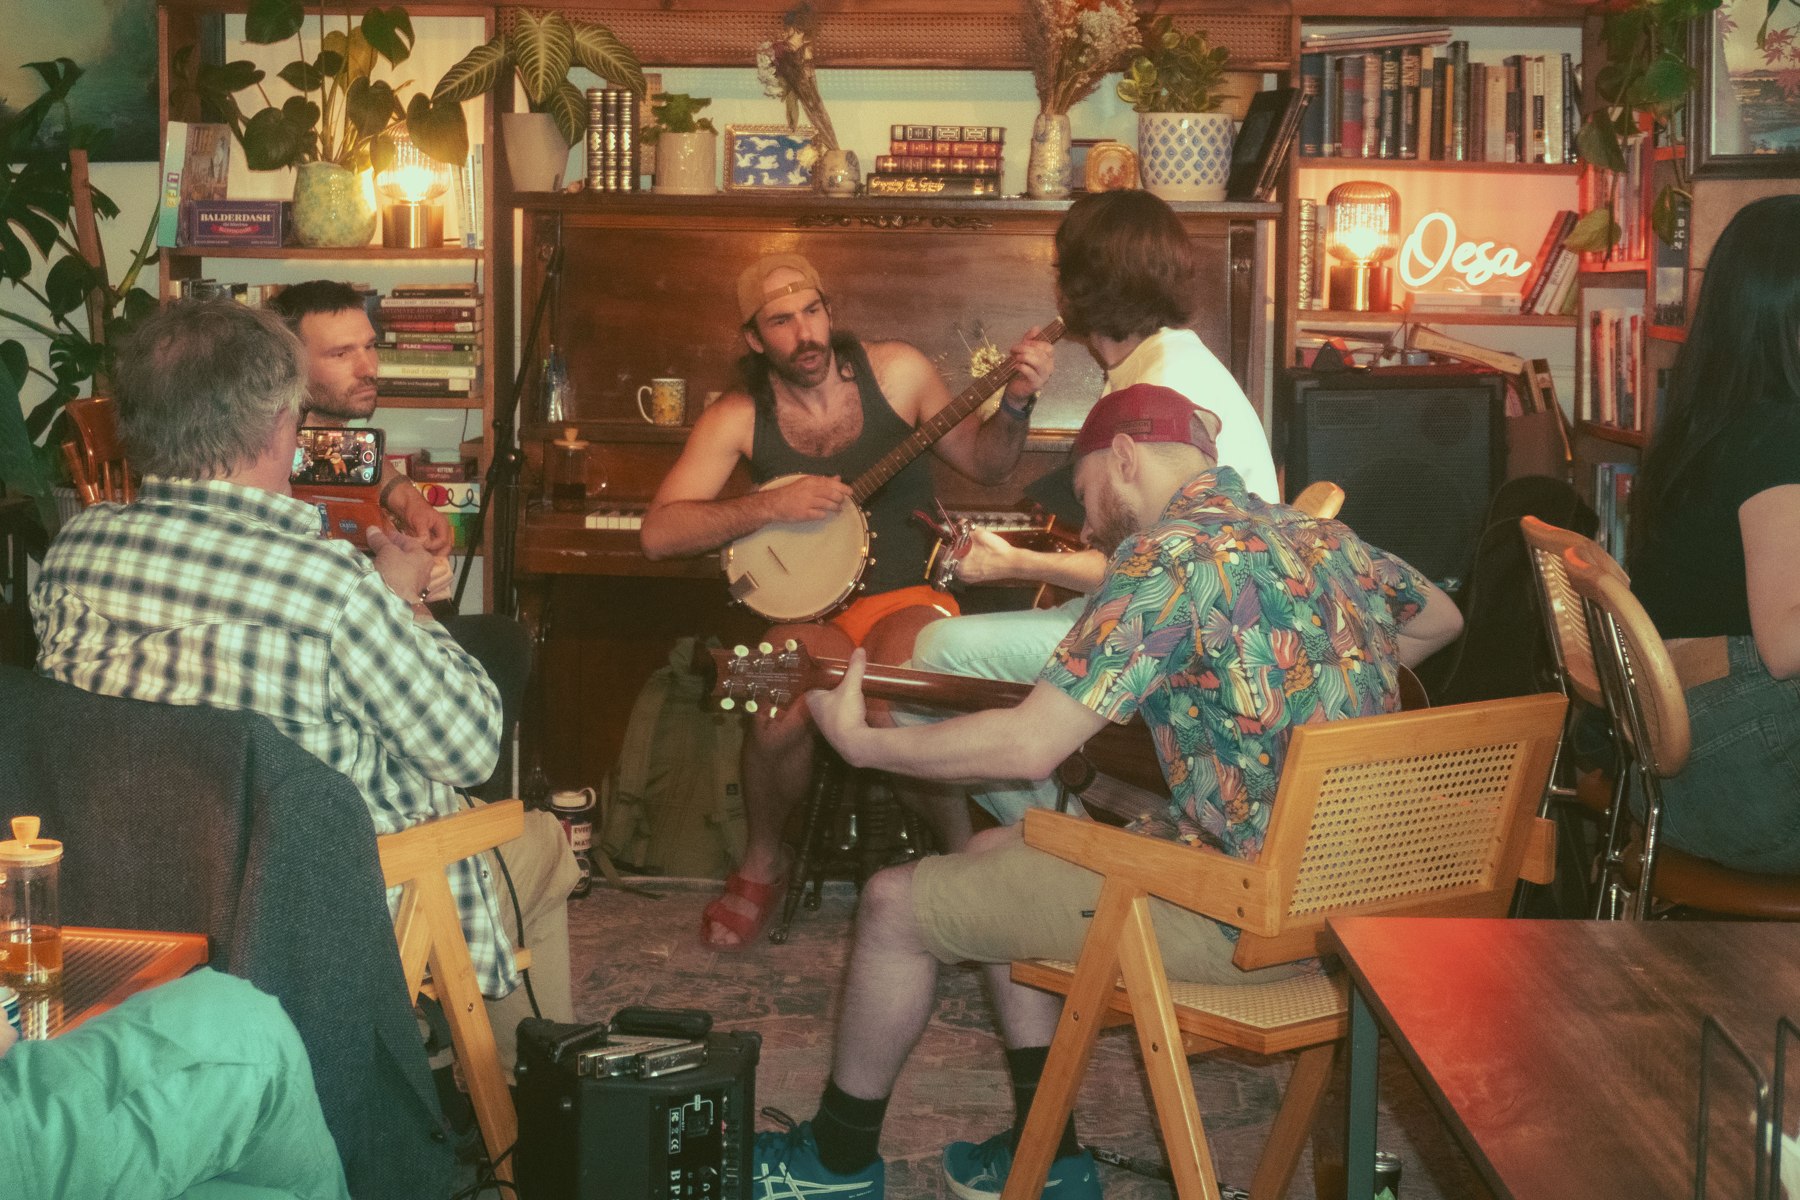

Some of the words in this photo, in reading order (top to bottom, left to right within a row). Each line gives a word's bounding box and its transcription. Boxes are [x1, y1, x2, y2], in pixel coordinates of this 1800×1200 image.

[1383, 61, 1394, 90] DUNE
[200, 213, 272, 222] BALDERDASH
[1400, 212, 1532, 286] Oesa
[422, 368, 449, 376] Ecology
